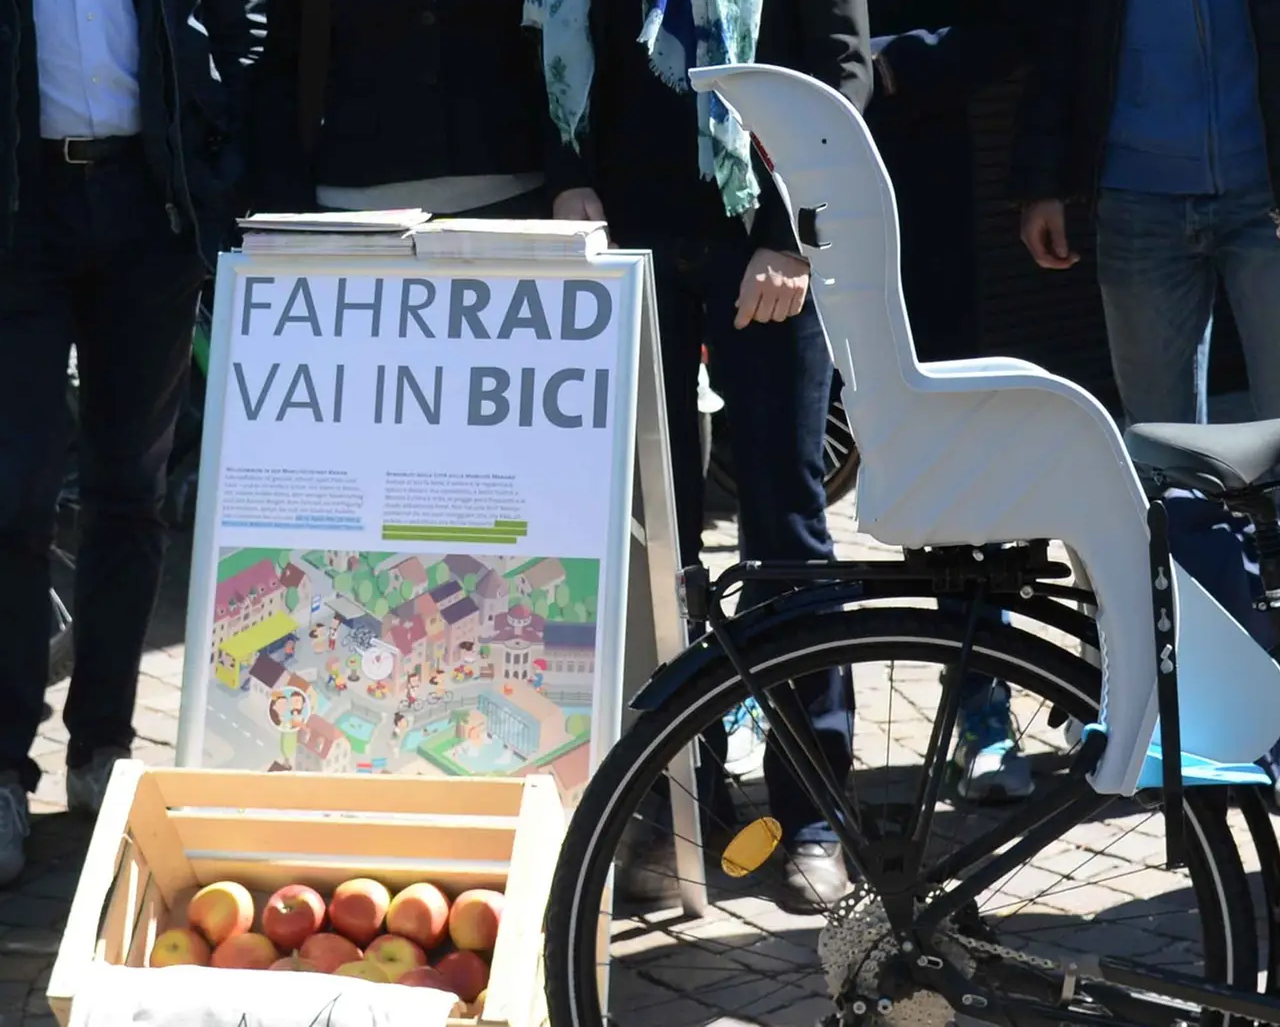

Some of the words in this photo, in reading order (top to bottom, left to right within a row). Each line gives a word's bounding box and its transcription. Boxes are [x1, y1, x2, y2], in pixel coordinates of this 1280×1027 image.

[241, 276, 612, 341] FAHRRAD
[232, 362, 344, 423] VAI
[373, 364, 444, 426] IN
[466, 365, 610, 430] BICI
